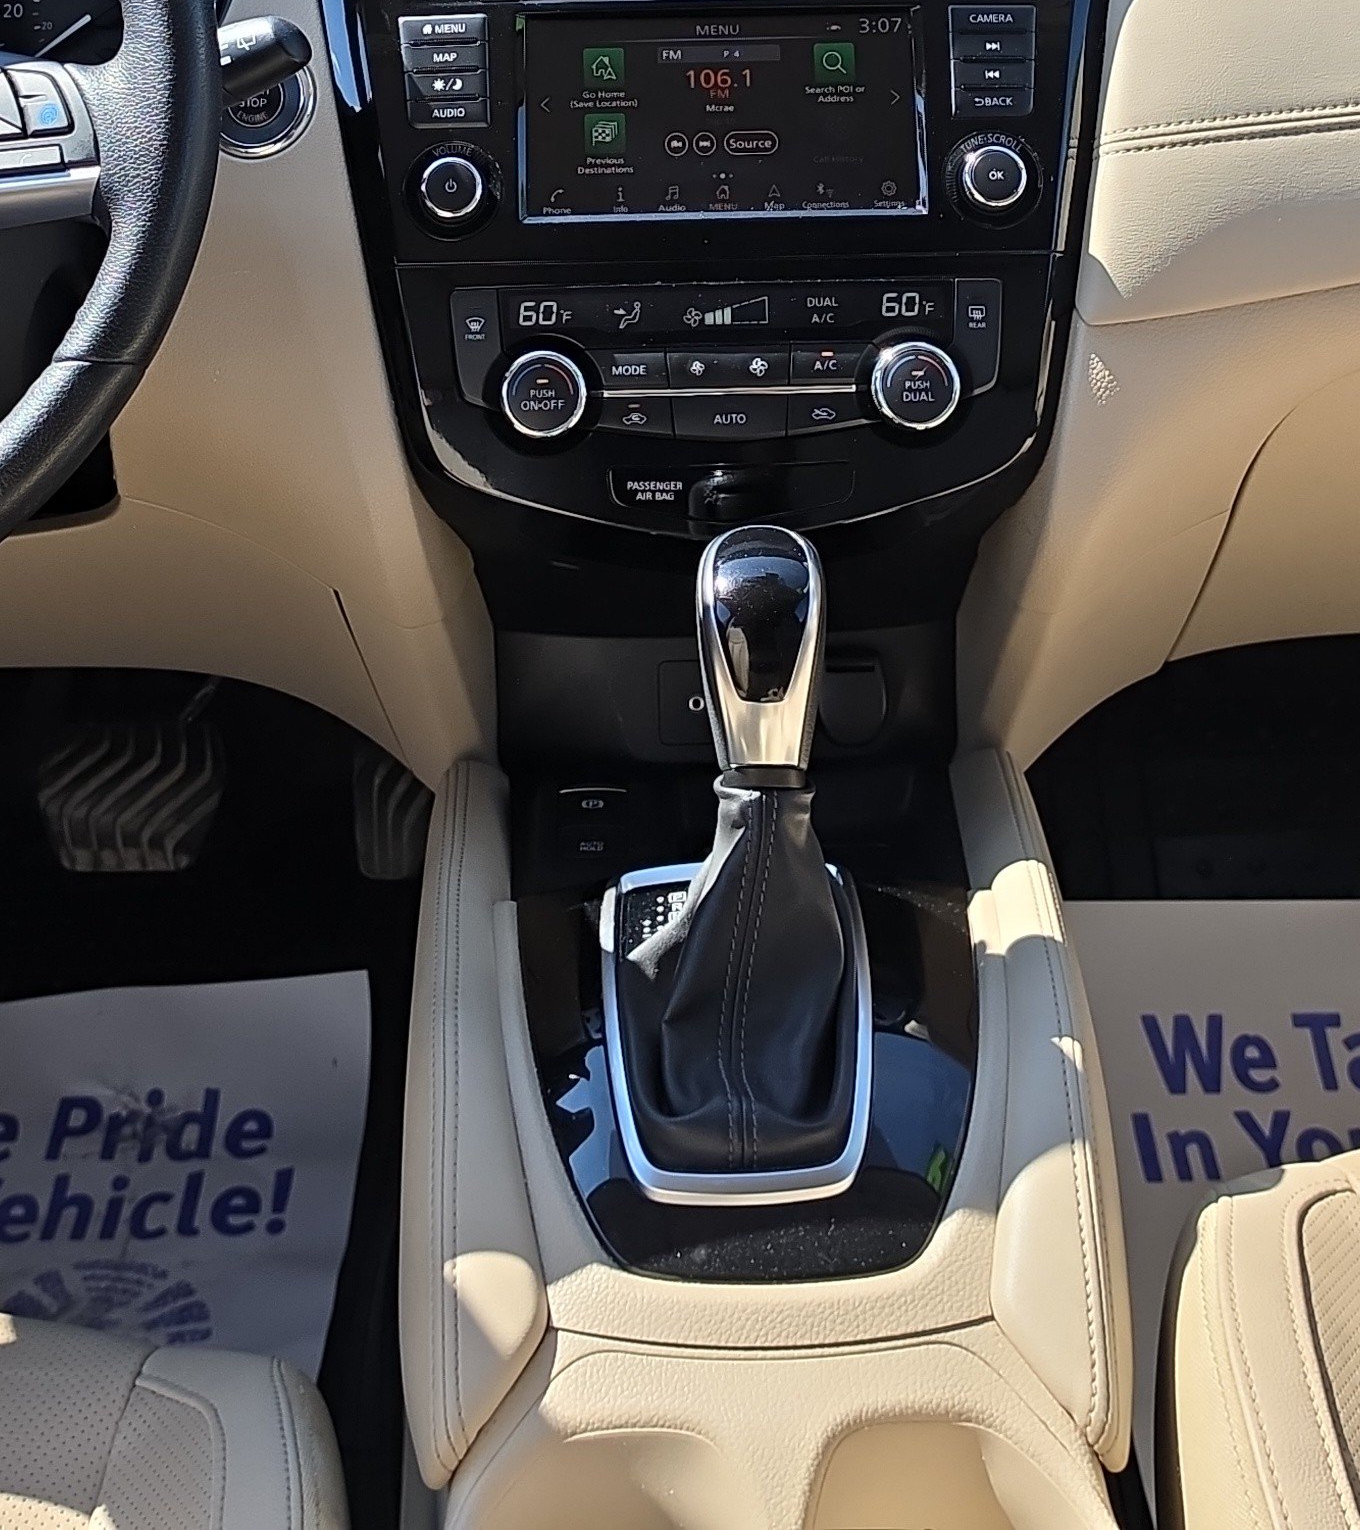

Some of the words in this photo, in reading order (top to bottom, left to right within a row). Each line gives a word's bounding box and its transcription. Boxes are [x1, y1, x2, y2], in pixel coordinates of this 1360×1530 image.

[2, 3, 24, 19] 20
[969, 13, 1013, 23] CAMERA
[434, 23, 466, 34] MENU
[696, 24, 740, 36] MENU
[858, 18, 902, 34] 3:07
[433, 53, 457, 62] MAP
[661, 50, 682, 61] FM
[685, 68, 751, 89] 106.1
[582, 91, 596, 99] Go
[597, 90, 625, 99] Home
[709, 89, 730, 99] FM
[804, 86, 835, 94] Search
[855, 85, 866, 93] or
[569, 100, 594, 109] (Save
[596, 98, 638, 109] Location)
[817, 95, 854, 103] Address
[985, 97, 1013, 106] BACK
[431, 108, 466, 119] AUDIO
[705, 104, 735, 113] Mcrae
[236, 110, 269, 123] ENGINE
[728, 138, 773, 149] Source
[431, 145, 473, 158] VOLUME
[586, 157, 624, 165] Previous
[577, 165, 634, 175] Destinations
[988, 170, 1004, 180] OK
[613, 205, 629, 213] Info
[658, 204, 686, 212] Audio
[709, 202, 738, 211] MENU
[764, 201, 785, 211] Map
[802, 201, 849, 209] Connections
[542, 206, 572, 215] Phone
[806, 297, 839, 308] DUAL
[811, 312, 835, 324] A/C
[611, 365, 647, 376] MODE
[813, 360, 838, 371] A/C
[904, 381, 930, 390] PUSH
[529, 389, 555, 398] PUSH
[903, 391, 935, 402] DUAL
[713, 413, 747, 424] AUTO
[627, 481, 683, 491] PASSENGER
[636, 492, 653, 501] AIR
[655, 492, 675, 501] BAG
[1141, 1012, 1280, 1096] We
[44, 1086, 275, 1164] Pride
[1130, 1112, 1222, 1184] In
